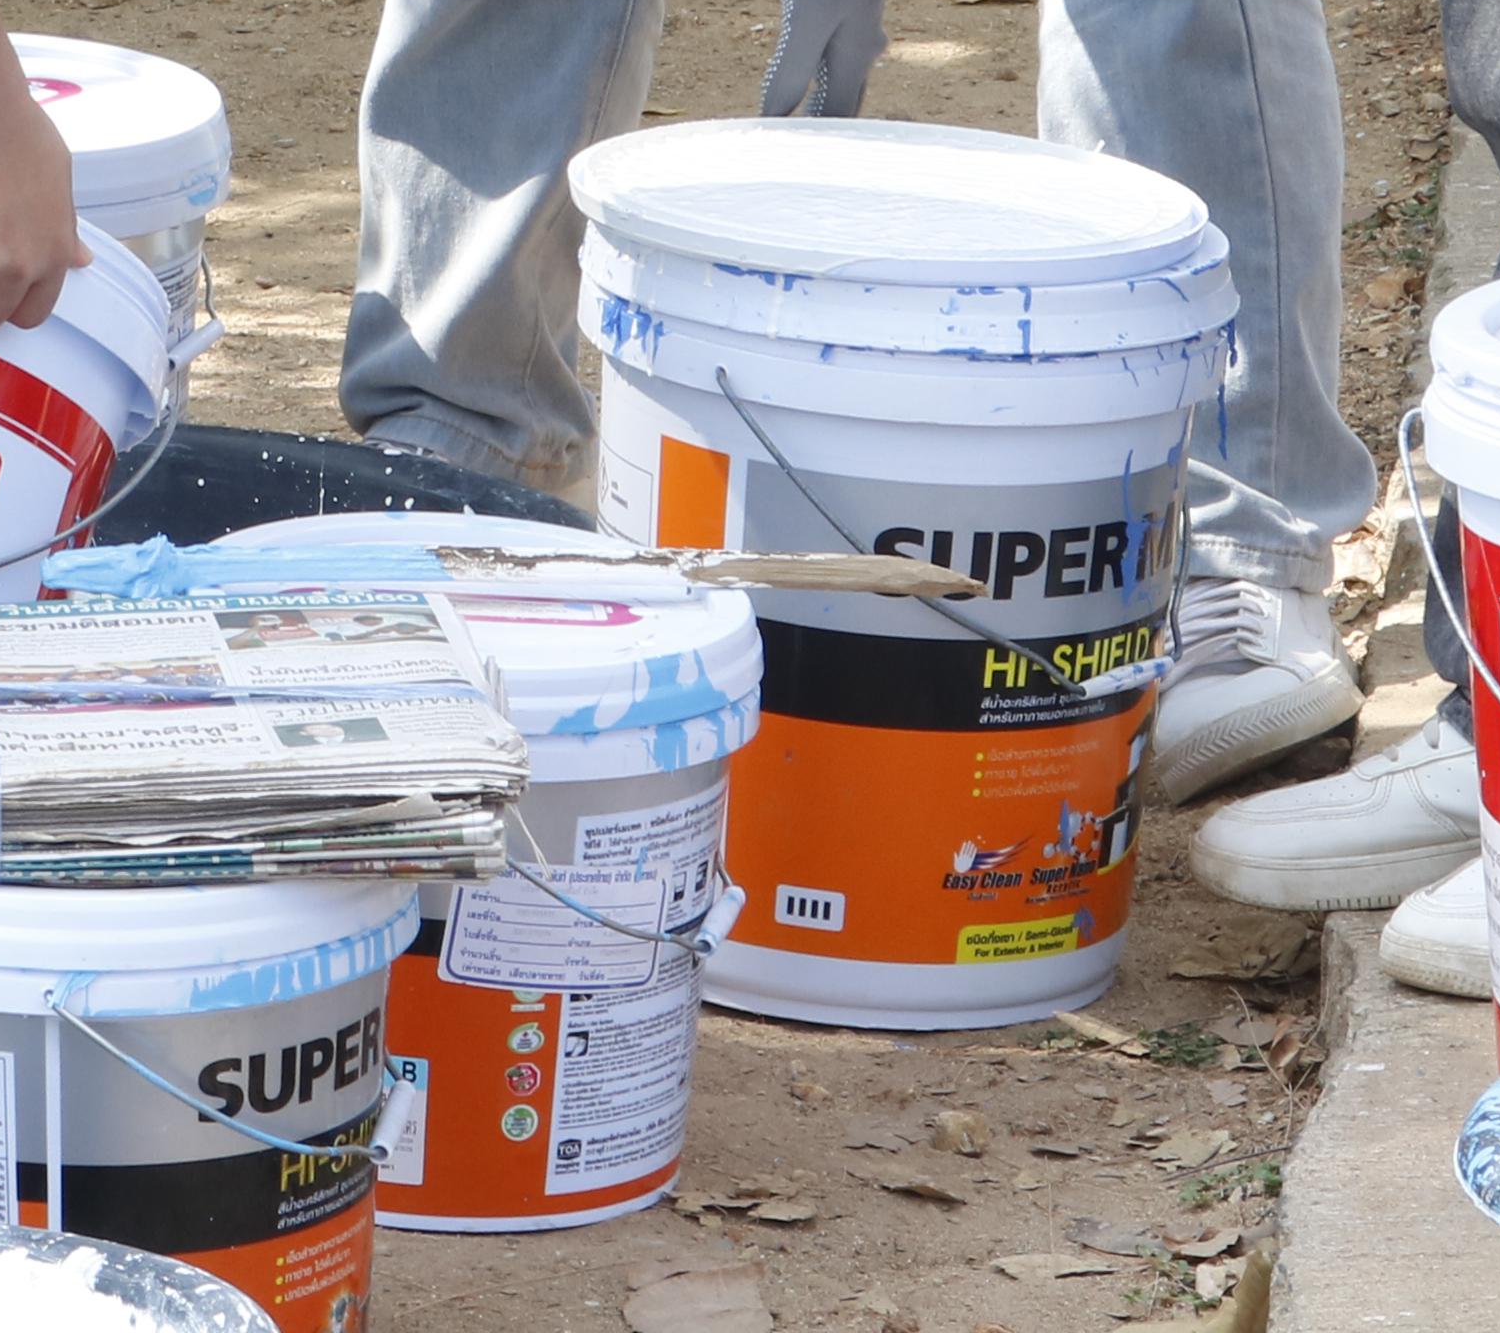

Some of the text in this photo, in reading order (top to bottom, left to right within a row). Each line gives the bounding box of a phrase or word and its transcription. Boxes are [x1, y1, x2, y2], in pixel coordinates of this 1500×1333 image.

[942, 873, 978, 890] Easy
[980, 872, 1023, 889] Clean
[1029, 866, 1068, 885] Super
[974, 949, 989, 958] For
[993, 946, 1026, 957] Exterior
[1038, 941, 1064, 953] Interior
[198, 1007, 381, 1123] SUPER
[402, 1061, 417, 1082] B
[558, 1143, 581, 1156] TOA
